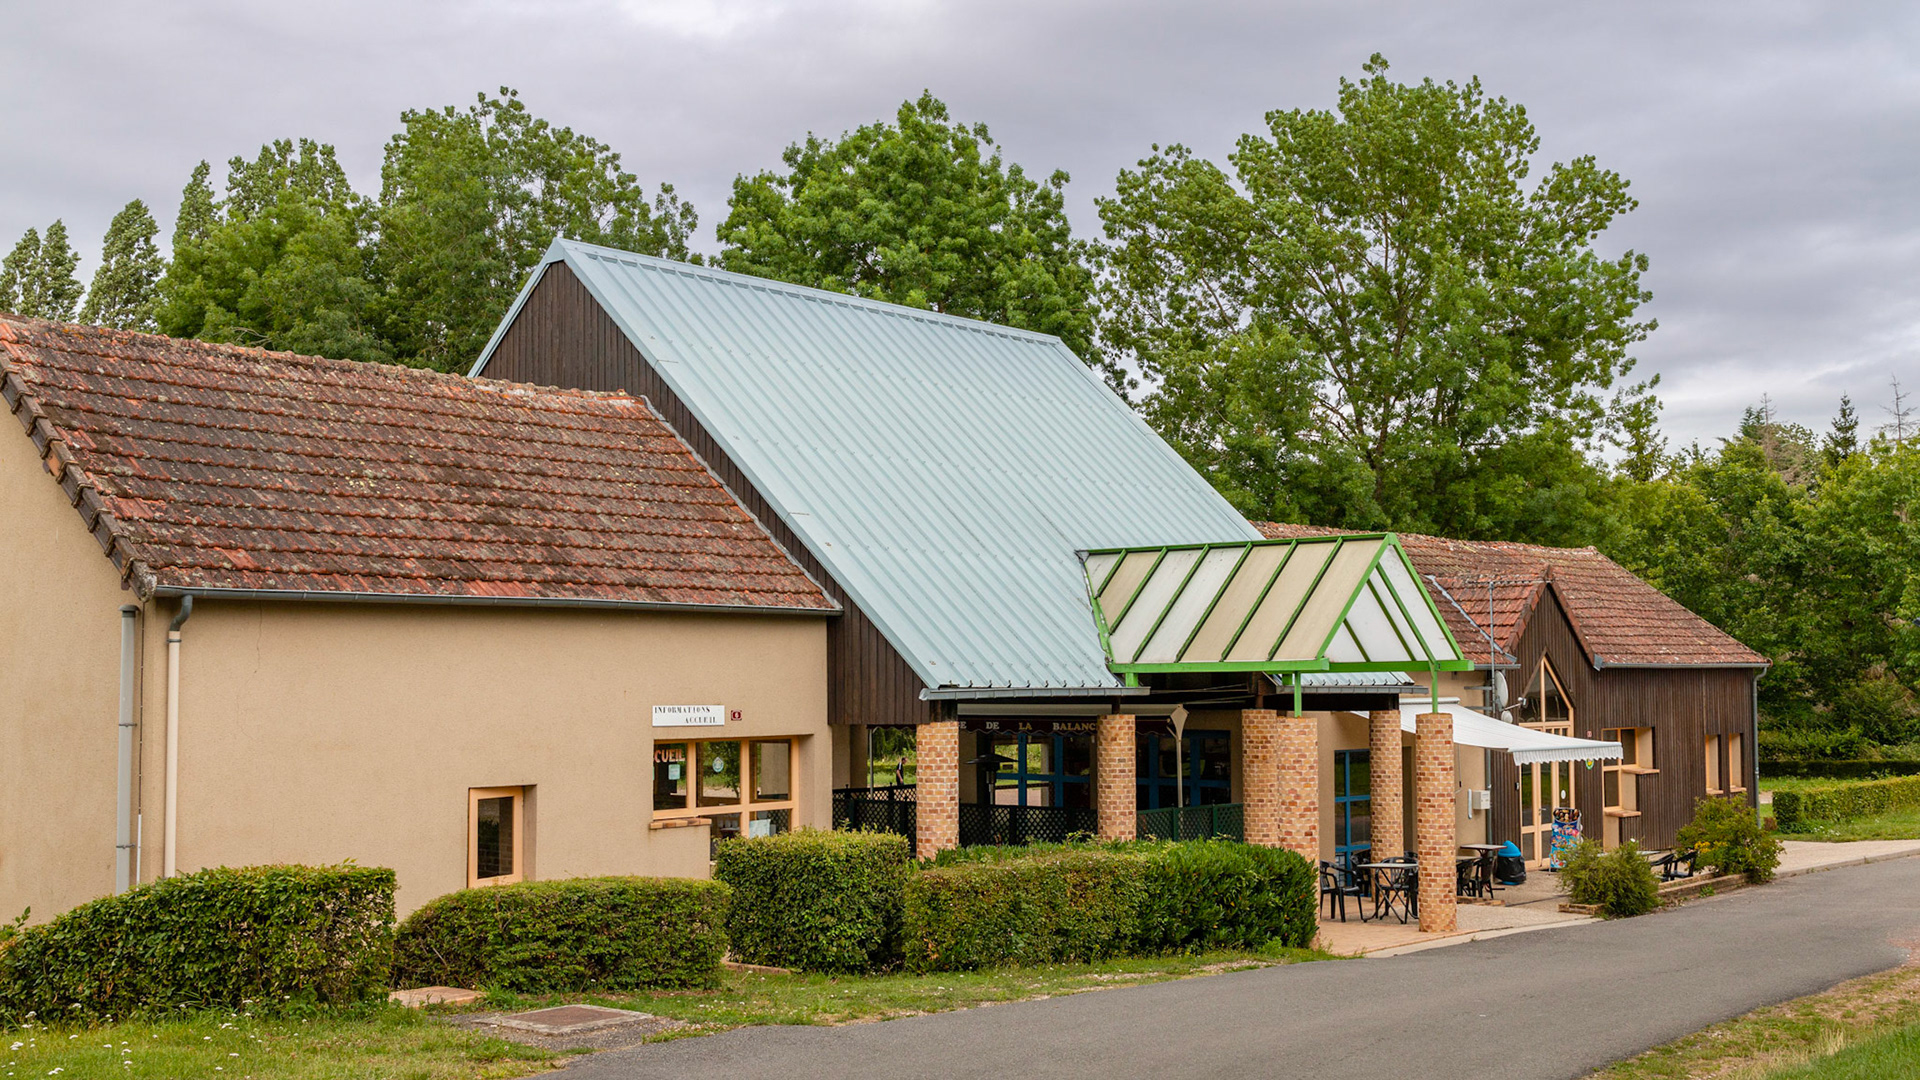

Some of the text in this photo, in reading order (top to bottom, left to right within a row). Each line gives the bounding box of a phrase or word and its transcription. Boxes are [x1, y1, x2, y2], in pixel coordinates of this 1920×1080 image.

[654, 706, 711, 714] INFORMATIONS
[685, 716, 717, 724] ACCUEIL
[985, 721, 1000, 730] DE
[1018, 722, 1033, 730] LA
[1053, 722, 1097, 731] BALANC
[654, 749, 686, 763] CUEIL
